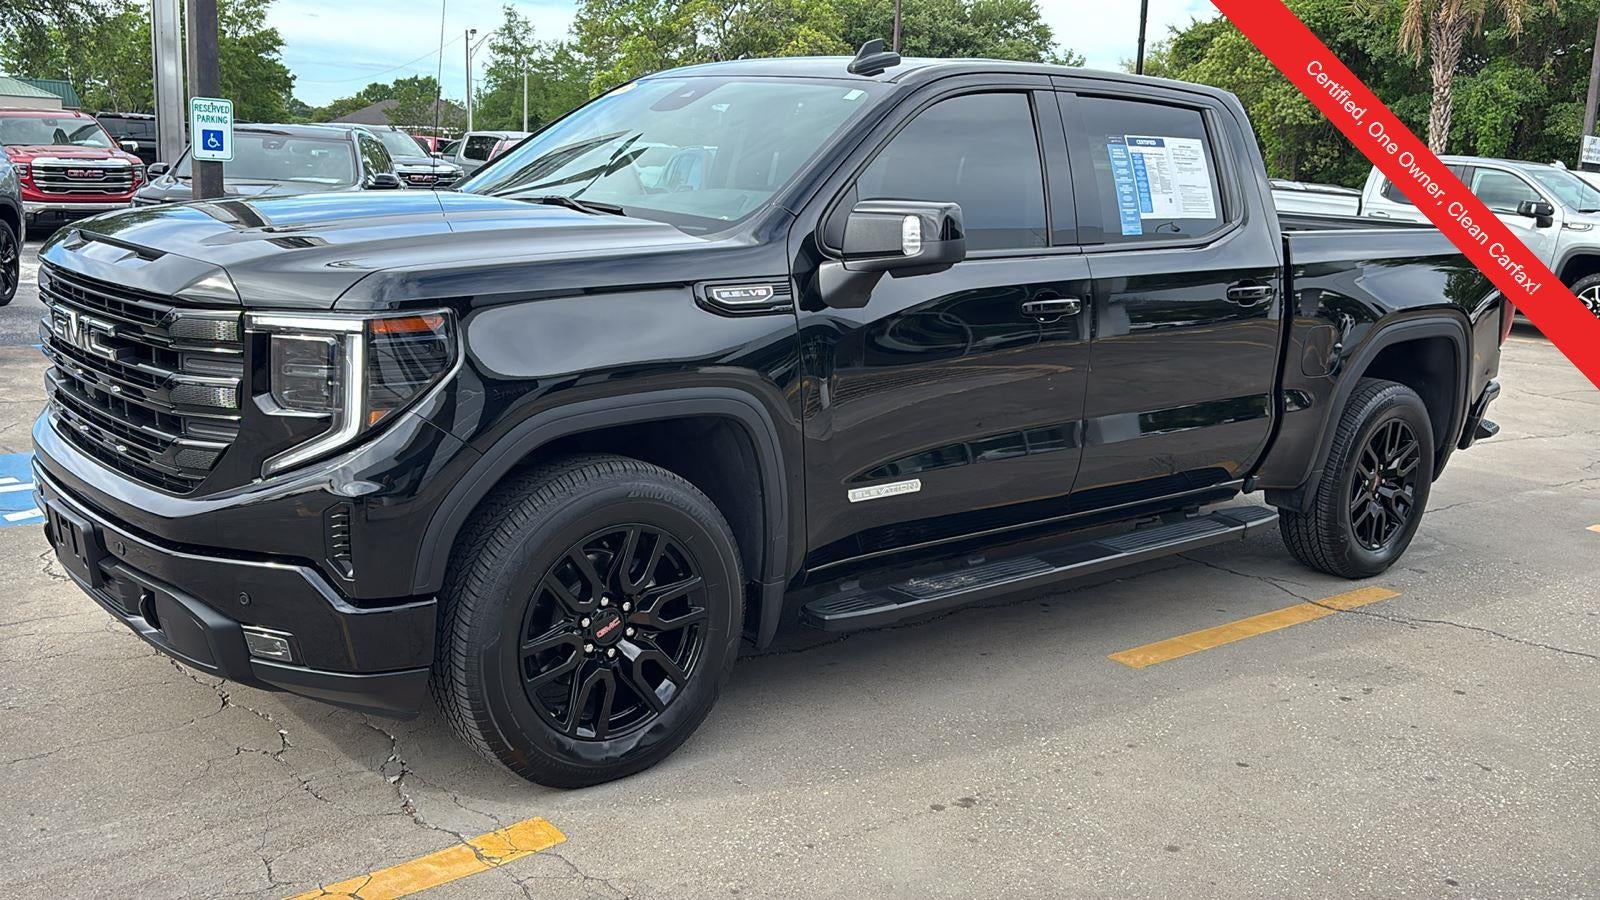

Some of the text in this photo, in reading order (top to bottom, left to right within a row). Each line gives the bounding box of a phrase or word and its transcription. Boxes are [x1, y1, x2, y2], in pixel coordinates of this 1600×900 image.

[194, 103, 229, 114] RESERVED
[197, 114, 228, 124] PARKING
[67, 169, 104, 177] GMC
[52, 303, 116, 361] GMC
[596, 616, 621, 638] GMC
